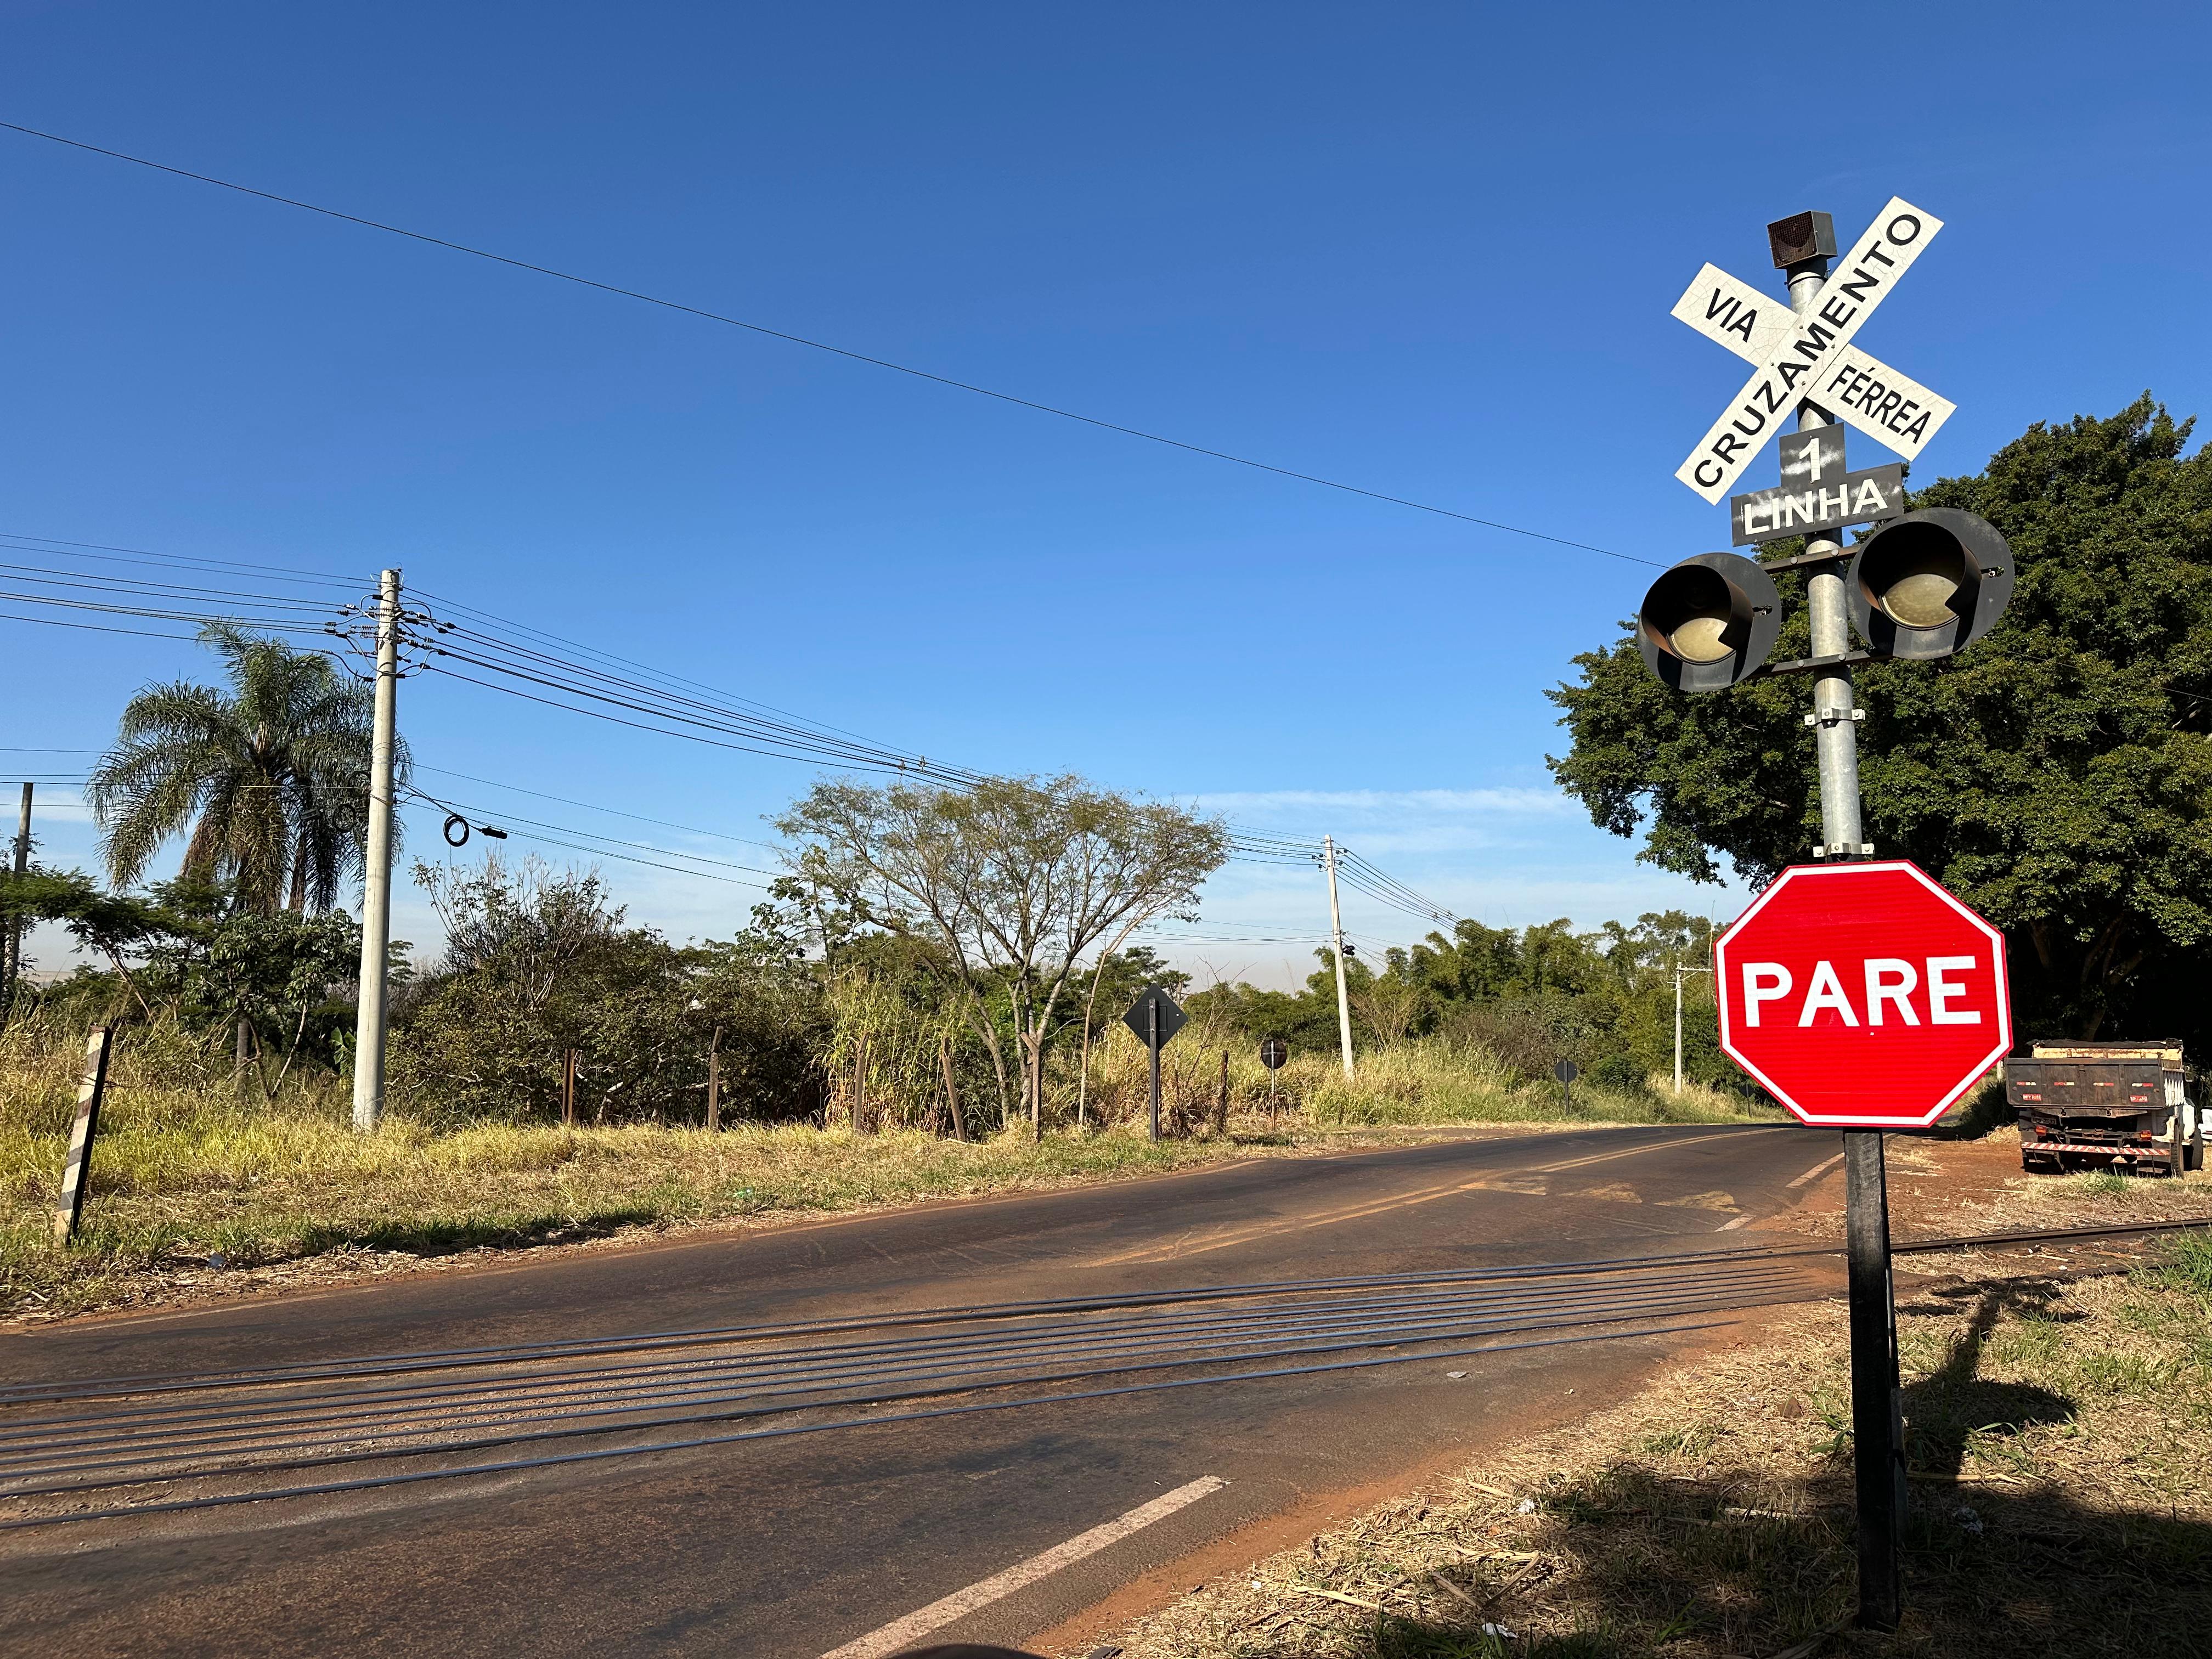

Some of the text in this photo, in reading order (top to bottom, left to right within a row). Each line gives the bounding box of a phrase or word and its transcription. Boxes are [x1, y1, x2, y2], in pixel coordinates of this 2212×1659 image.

[1694, 213, 1921, 488] CRUZAMENTO
[1705, 287, 1932, 444] VIA FÉRREA
[1798, 437, 1822, 481] 1
[1744, 478, 1888, 535] LINHA
[1742, 955, 1982, 1028] PARE
